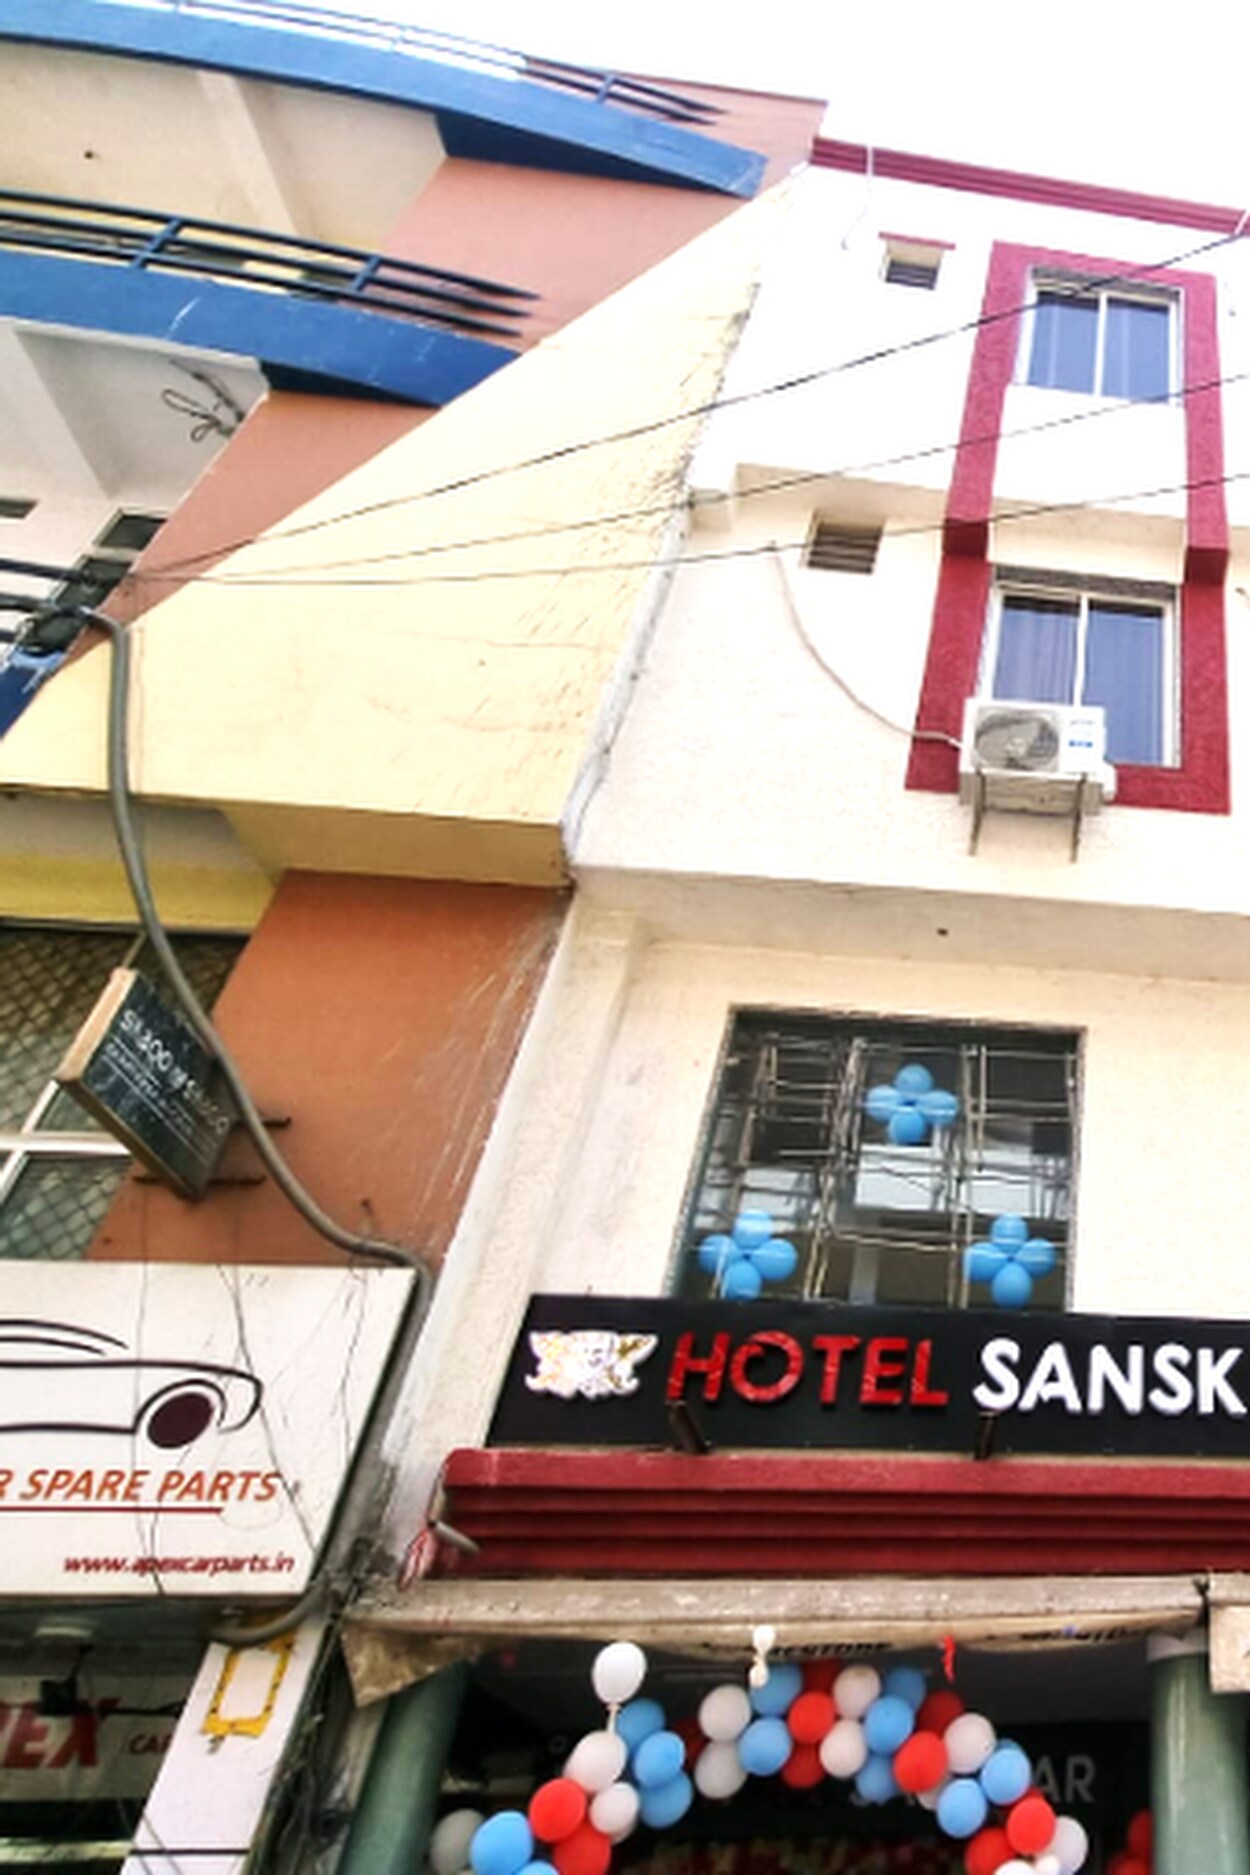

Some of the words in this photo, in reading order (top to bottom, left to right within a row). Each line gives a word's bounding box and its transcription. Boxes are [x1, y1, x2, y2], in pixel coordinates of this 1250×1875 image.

[666, 1329, 949, 1406] HOTEL
[18, 1468, 151, 1501] SPARE
[156, 1469, 284, 1502] PARTS
[64, 1551, 295, 1577] www.apexcarparts.in
